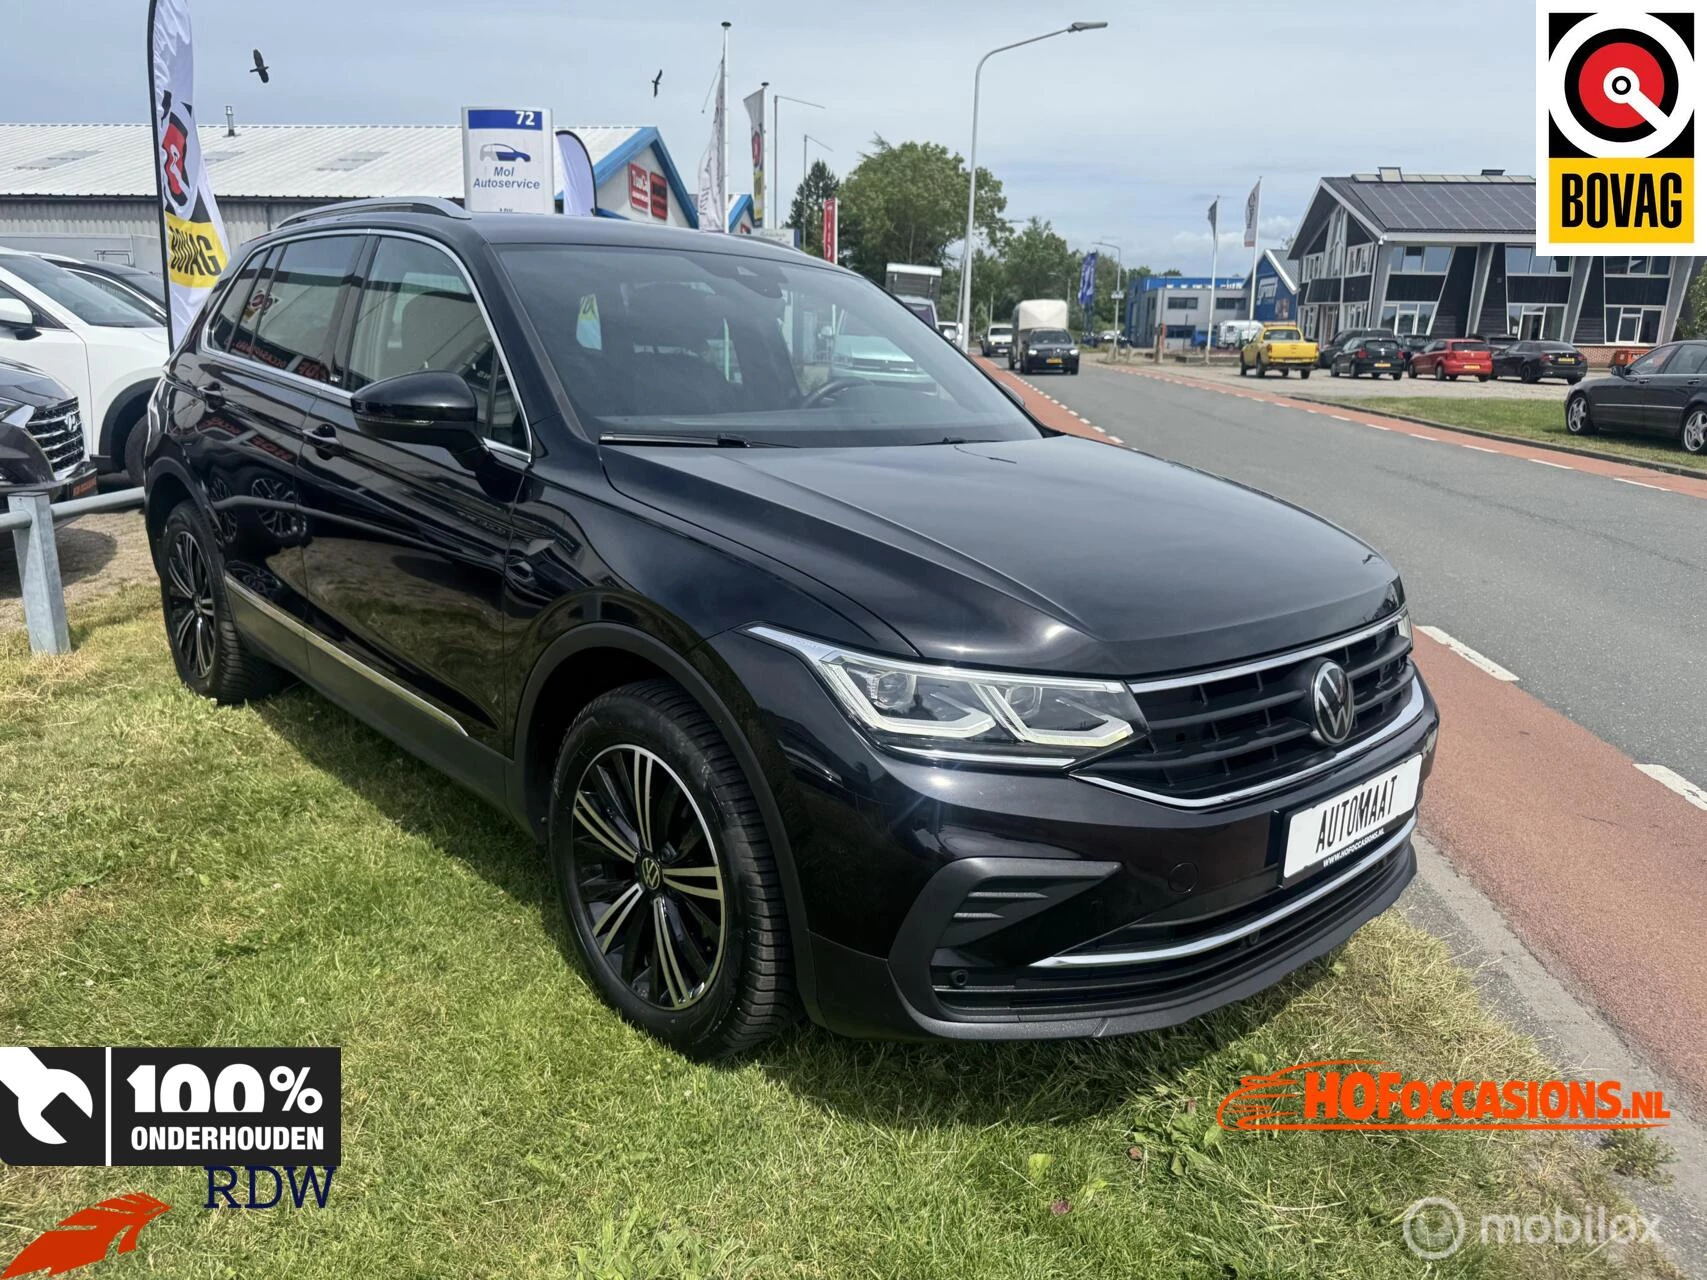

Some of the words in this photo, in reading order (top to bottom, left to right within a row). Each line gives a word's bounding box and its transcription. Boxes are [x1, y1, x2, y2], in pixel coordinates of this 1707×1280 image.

[515, 111, 535, 126] 72
[494, 167, 515, 177] Mol
[473, 178, 541, 190] Autoservice
[1316, 775, 1398, 854] AUTOMAAT
